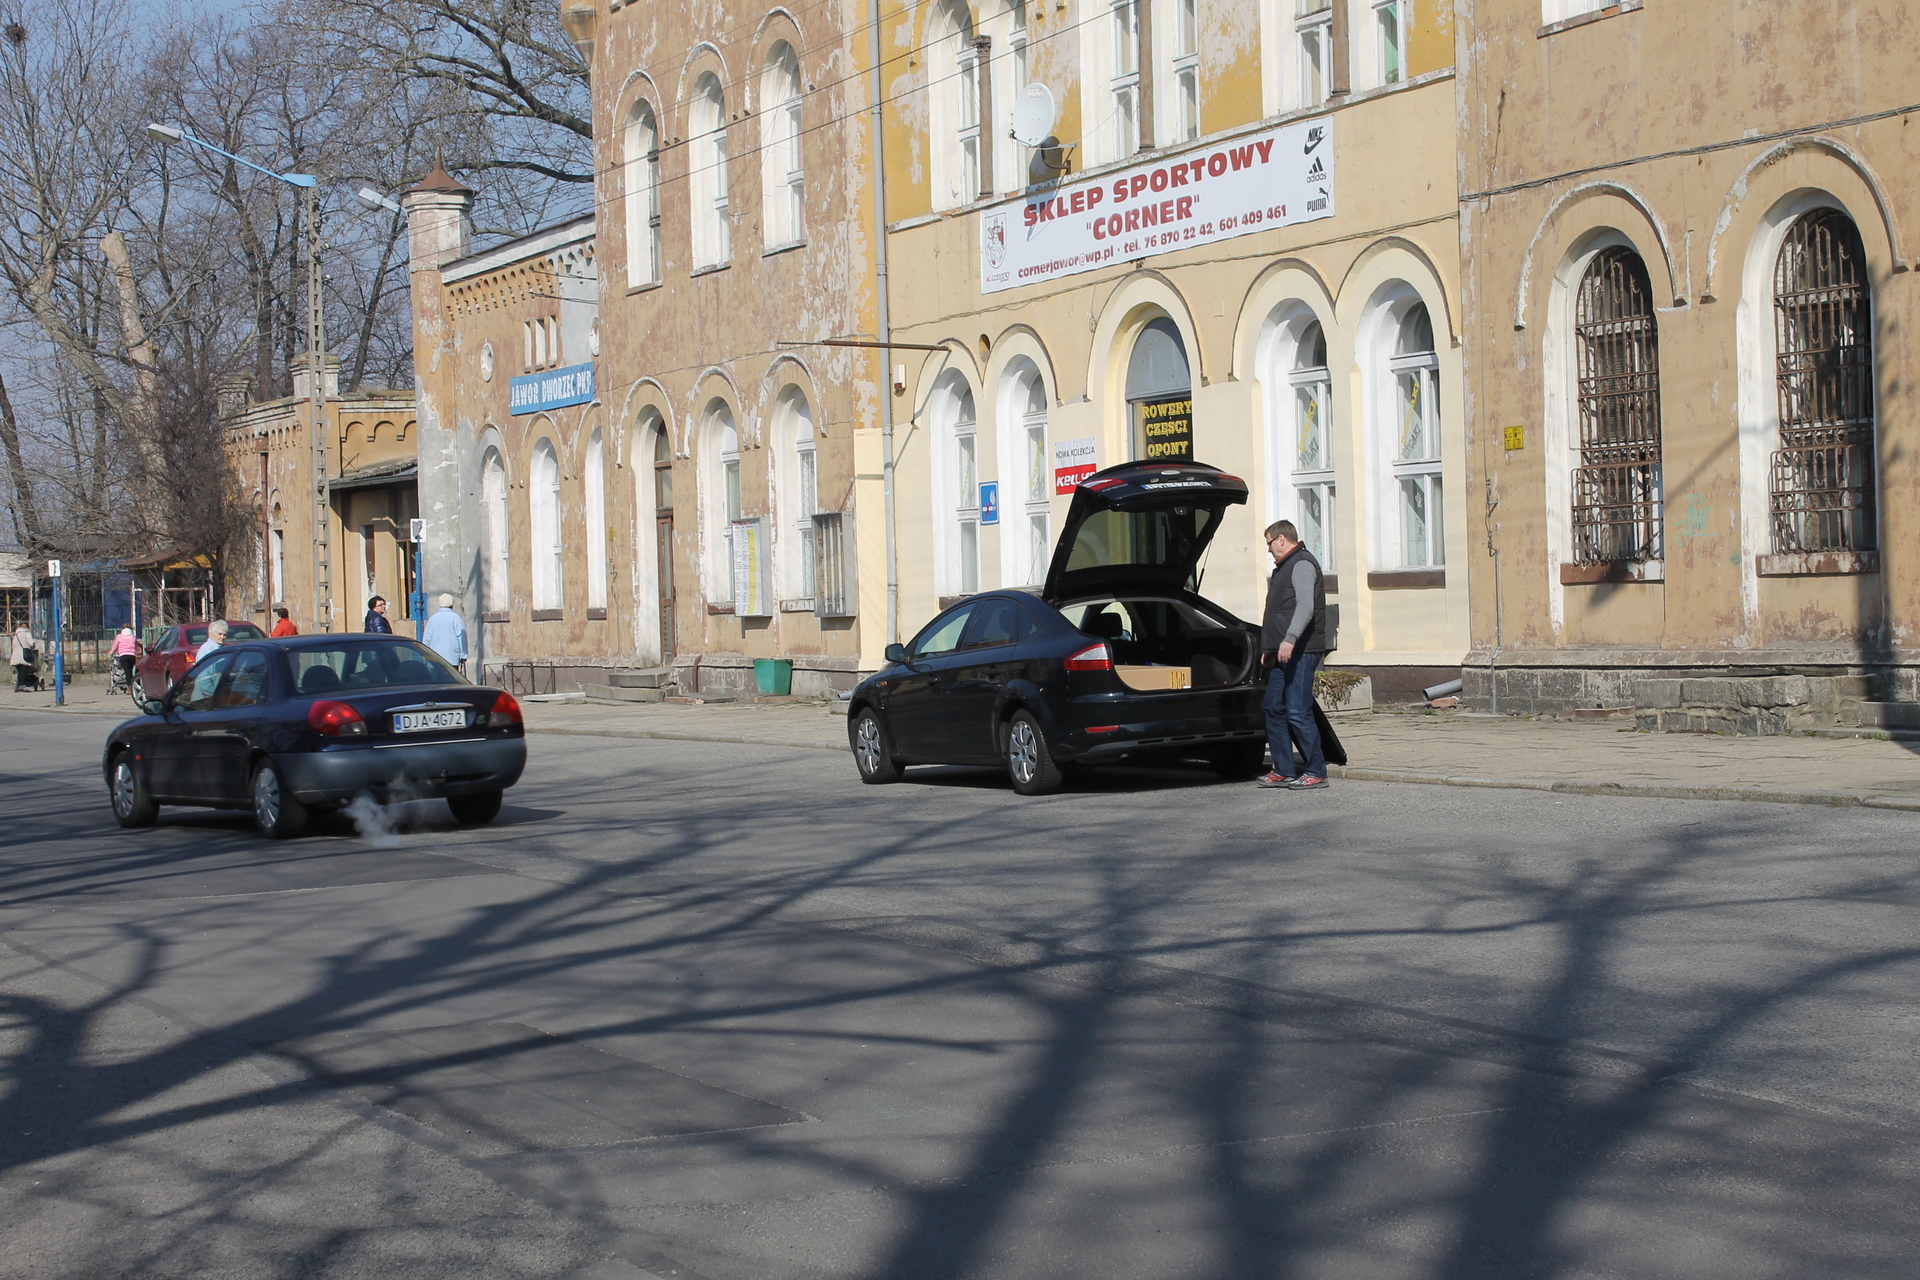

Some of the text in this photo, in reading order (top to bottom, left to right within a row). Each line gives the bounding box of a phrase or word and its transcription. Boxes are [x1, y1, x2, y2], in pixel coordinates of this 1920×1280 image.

[1308, 126, 1324, 142] NIKE
[1023, 138, 1275, 227] SKLEP SPORTOWY
[1306, 172, 1327, 183] adidas
[1307, 197, 1327, 213] PUMA
[1086, 194, 1200, 241] "CORNER"
[1018, 204, 1287, 278] cornerjawor@wp.pl tel. 76 870 22 42, 601 409 461
[510, 370, 592, 408] JAWOR DWORZEC PKP
[1141, 401, 1192, 419] ROWERY
[1146, 416, 1188, 437] CZĘŚCI
[1055, 446, 1096, 460] NOWA KOLEKCJA
[1147, 440, 1189, 458] OPONY
[402, 714, 429, 729] DJA
[433, 711, 462, 727] 4G72
